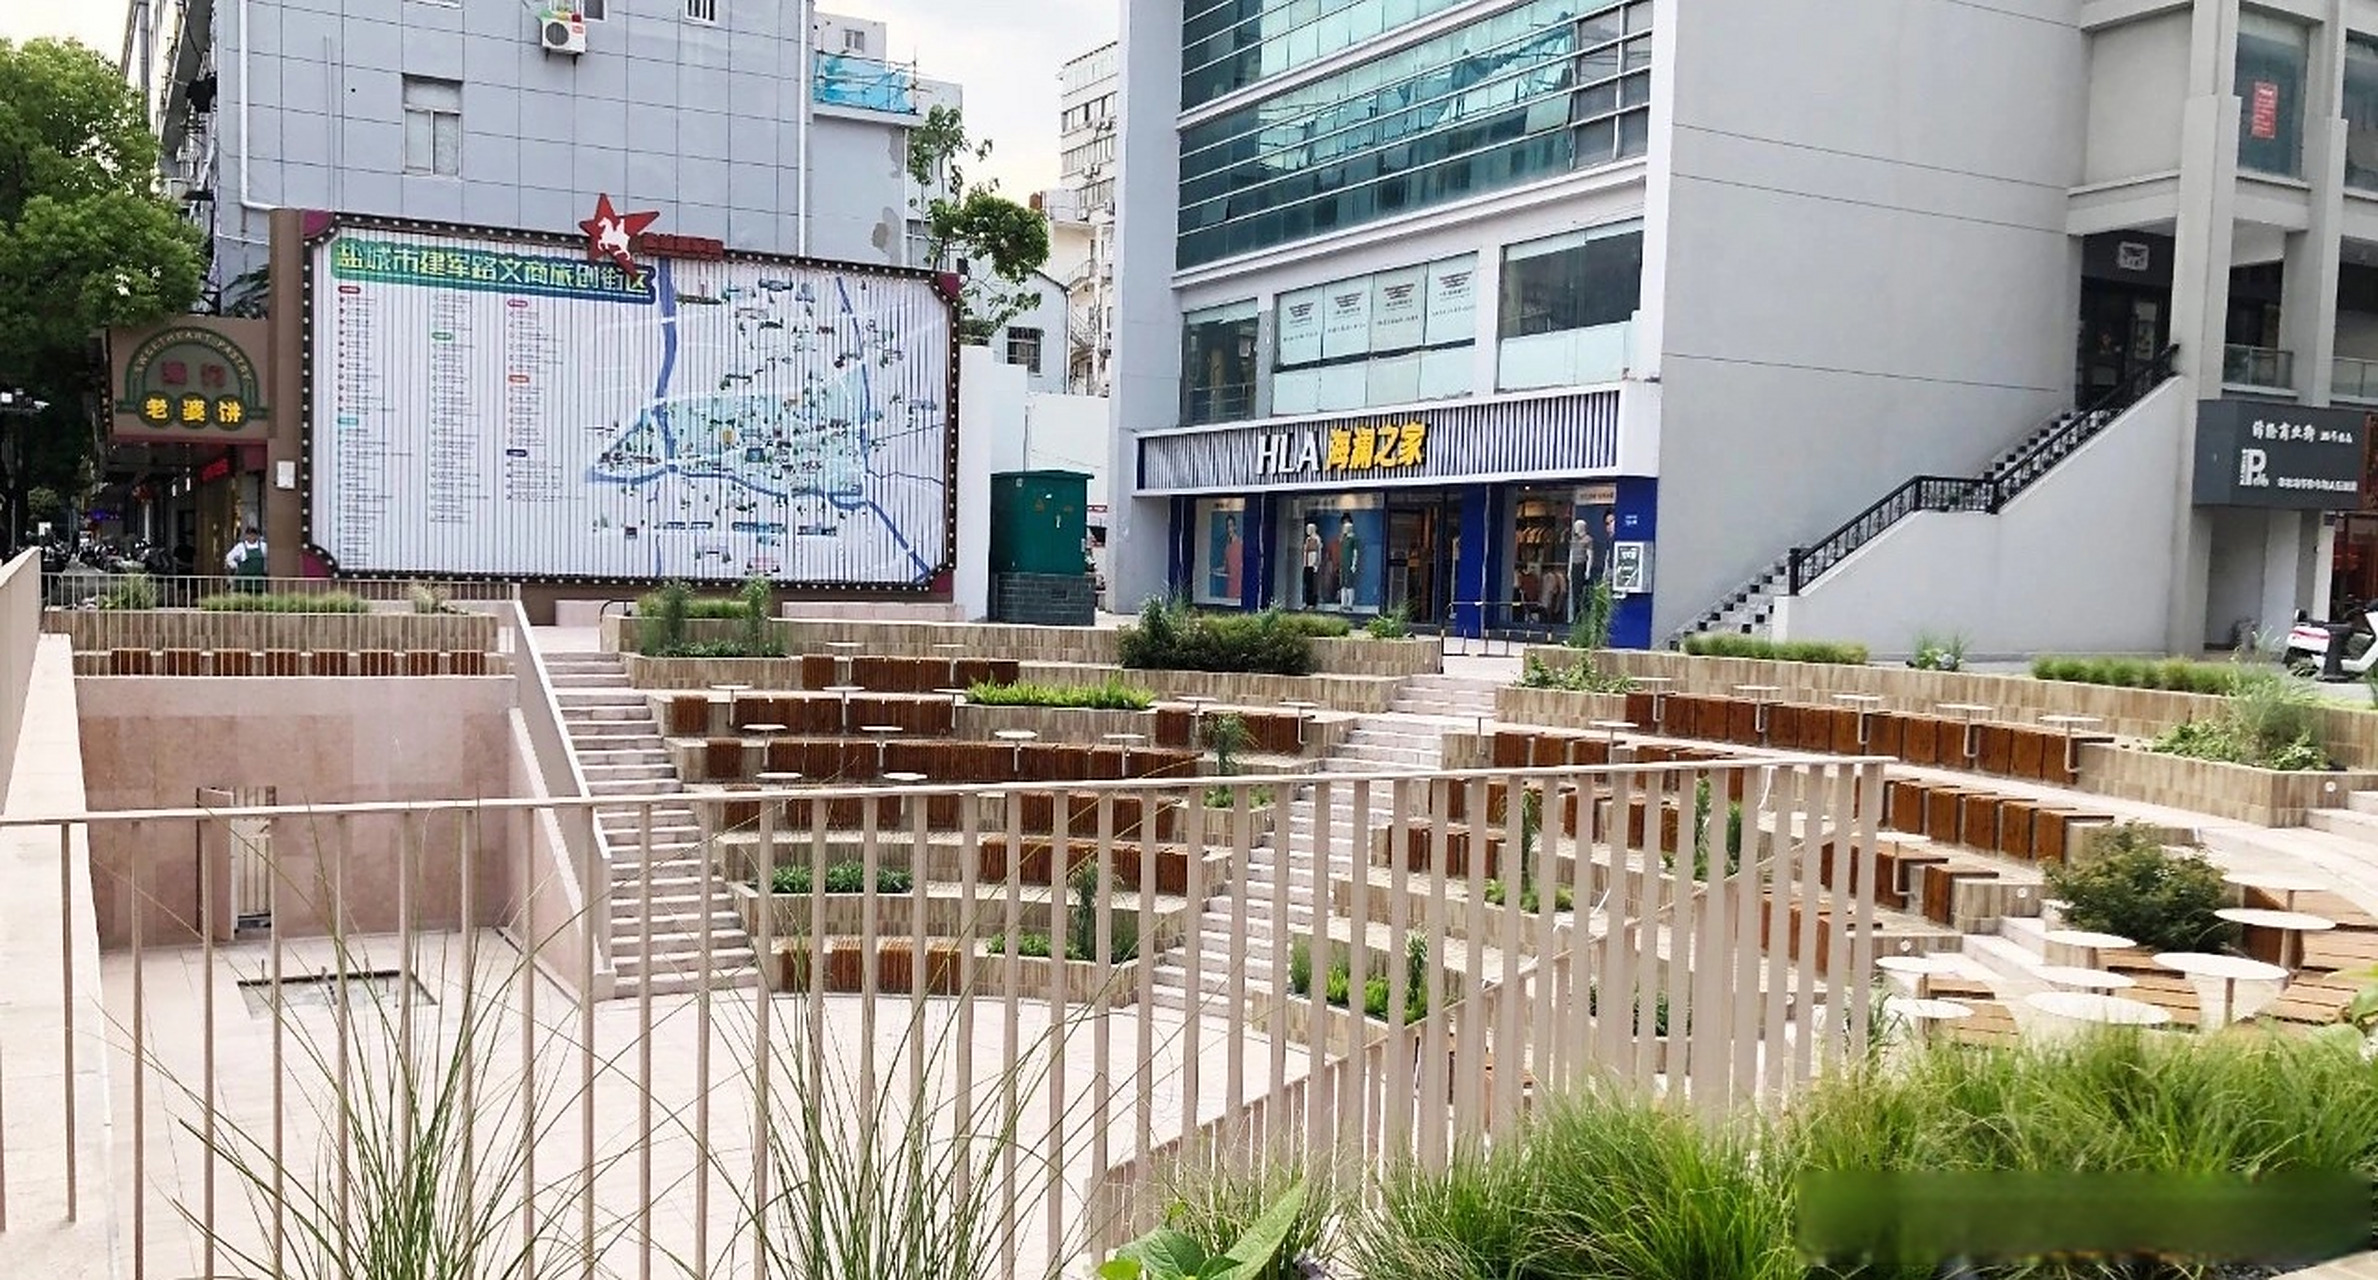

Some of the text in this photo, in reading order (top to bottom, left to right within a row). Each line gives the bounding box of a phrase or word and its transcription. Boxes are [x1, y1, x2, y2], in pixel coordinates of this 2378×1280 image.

[145, 397, 242, 423] 老婆饼
[1256, 421, 1427, 475] HLA 海澜之家
